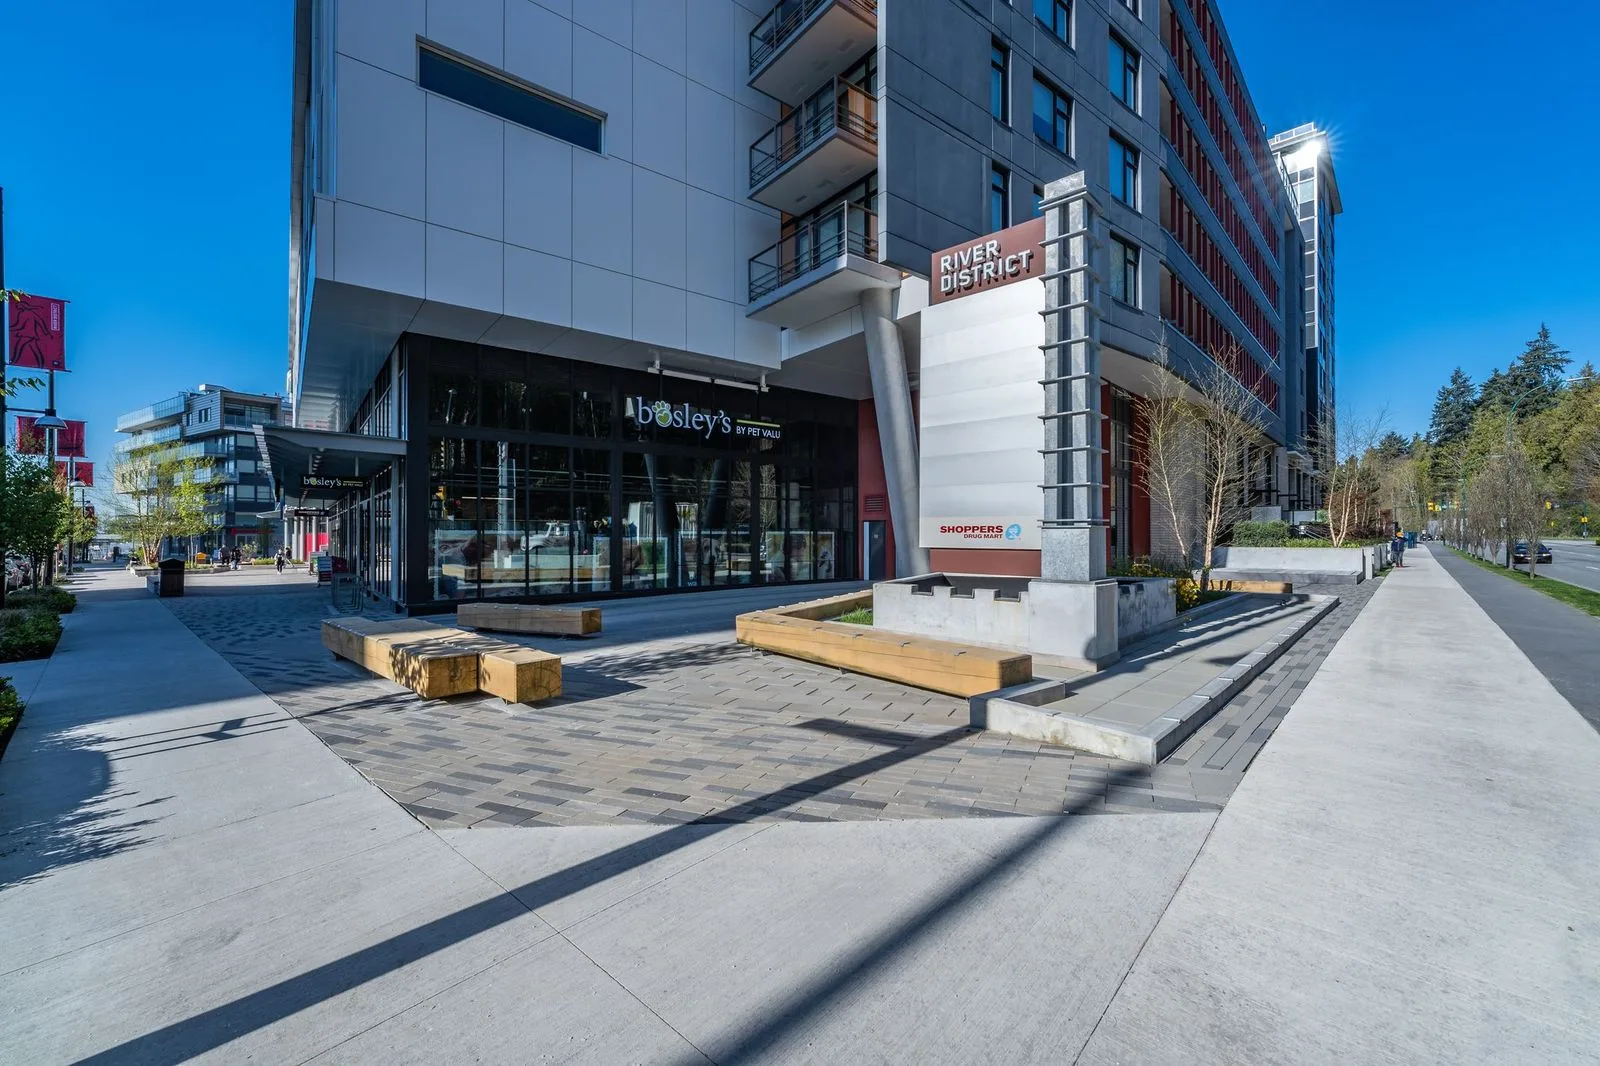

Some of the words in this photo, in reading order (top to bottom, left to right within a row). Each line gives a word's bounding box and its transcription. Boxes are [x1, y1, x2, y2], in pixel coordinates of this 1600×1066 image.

[941, 240, 999, 273] RIVER
[941, 249, 1031, 292] DISTRICT
[636, 397, 732, 439] bosley's
[736, 425, 747, 435] BY
[747, 427, 760, 437] PET
[761, 429, 781, 439] VALU
[303, 476, 342, 489] bosley's
[940, 525, 1003, 534] SHOPPERS
